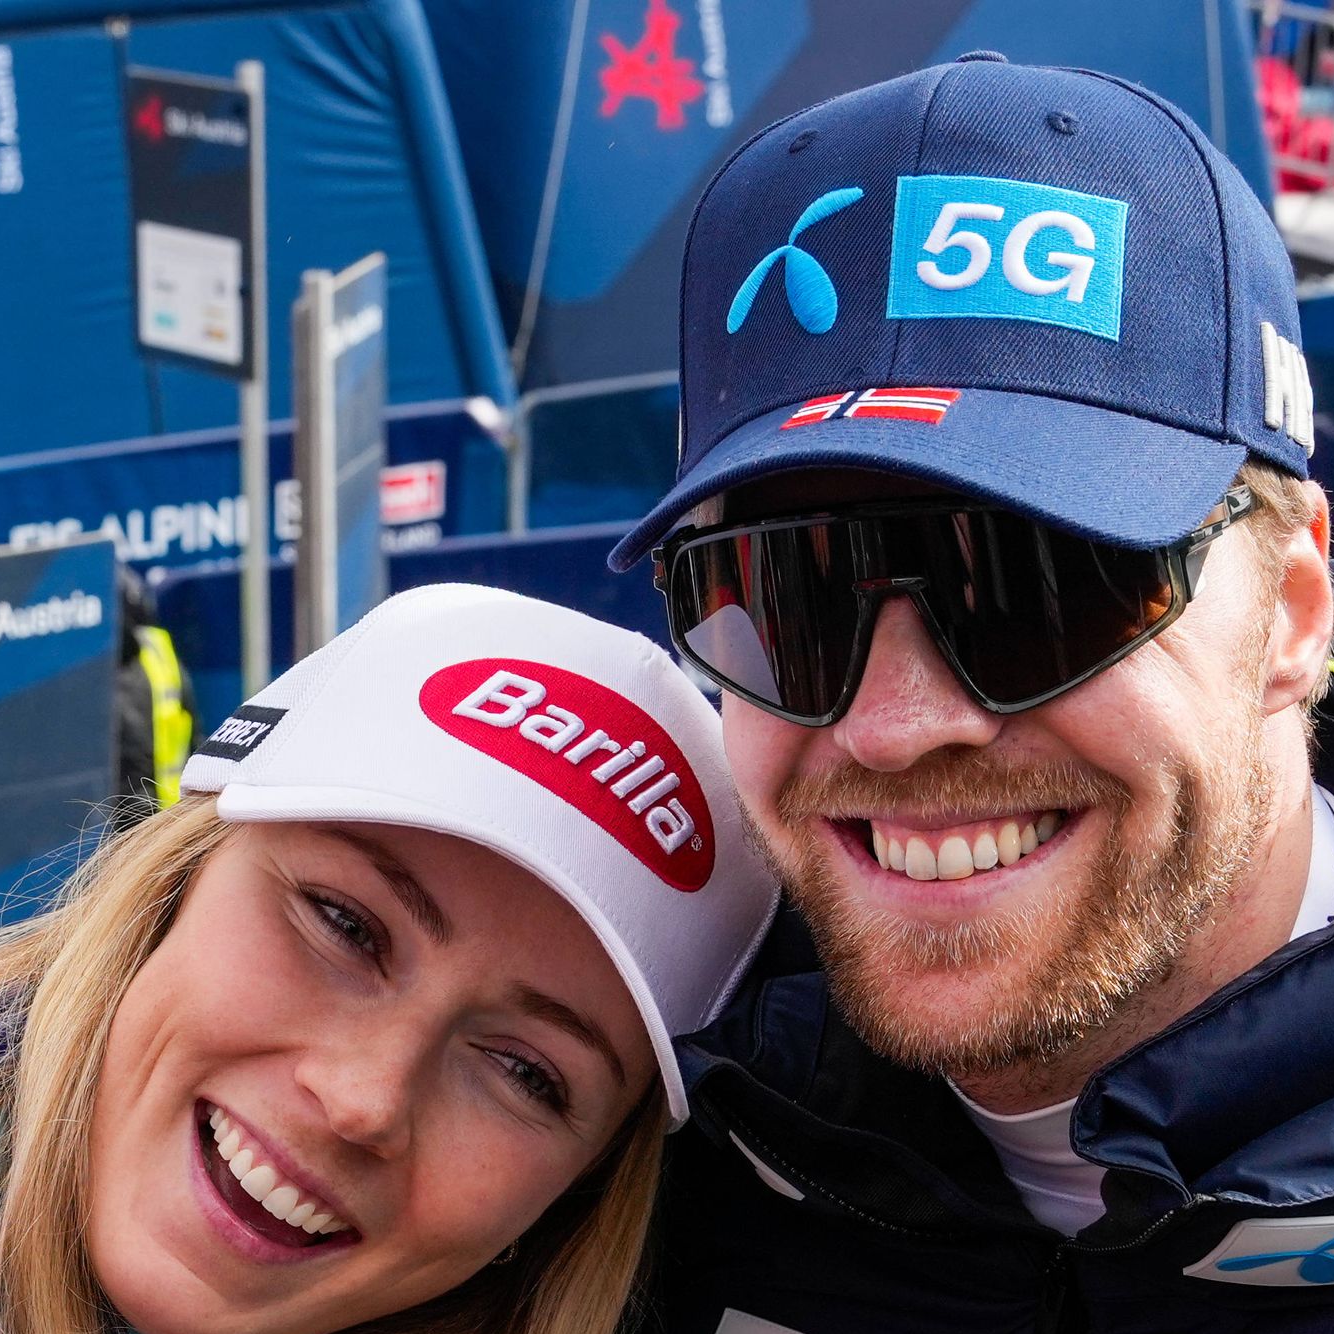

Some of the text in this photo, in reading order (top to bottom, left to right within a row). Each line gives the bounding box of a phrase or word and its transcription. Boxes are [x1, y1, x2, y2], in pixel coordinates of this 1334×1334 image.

[916, 202, 1096, 304] 5G
[101, 496, 251, 562] ALPIN
[206, 716, 272, 748] ERREX
[451, 669, 695, 855] Barilla
